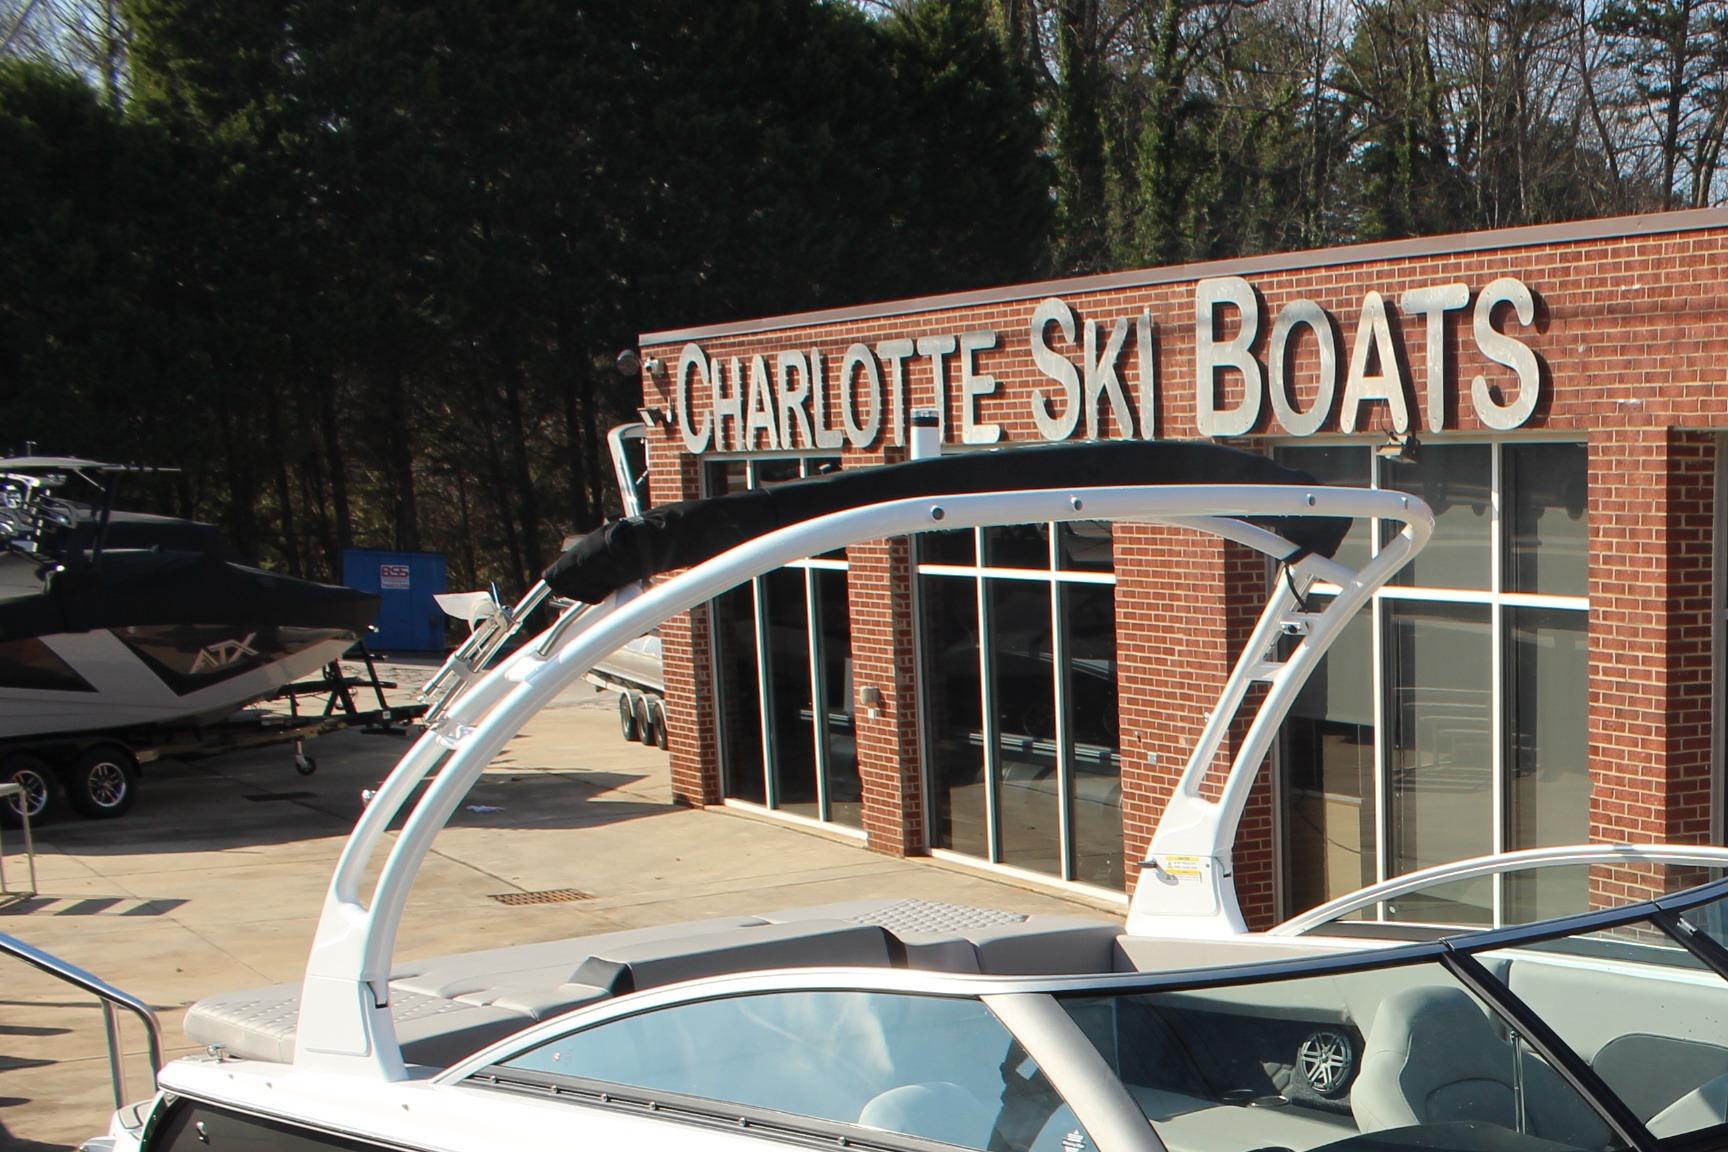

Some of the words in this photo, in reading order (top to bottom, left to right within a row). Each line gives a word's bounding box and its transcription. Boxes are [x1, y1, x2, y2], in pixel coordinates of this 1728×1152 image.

[677, 332, 1000, 454] CHARLOTTE
[1031, 298, 1155, 441] SKI
[1196, 276, 1540, 437] BOATS
[190, 631, 259, 675] ATX
